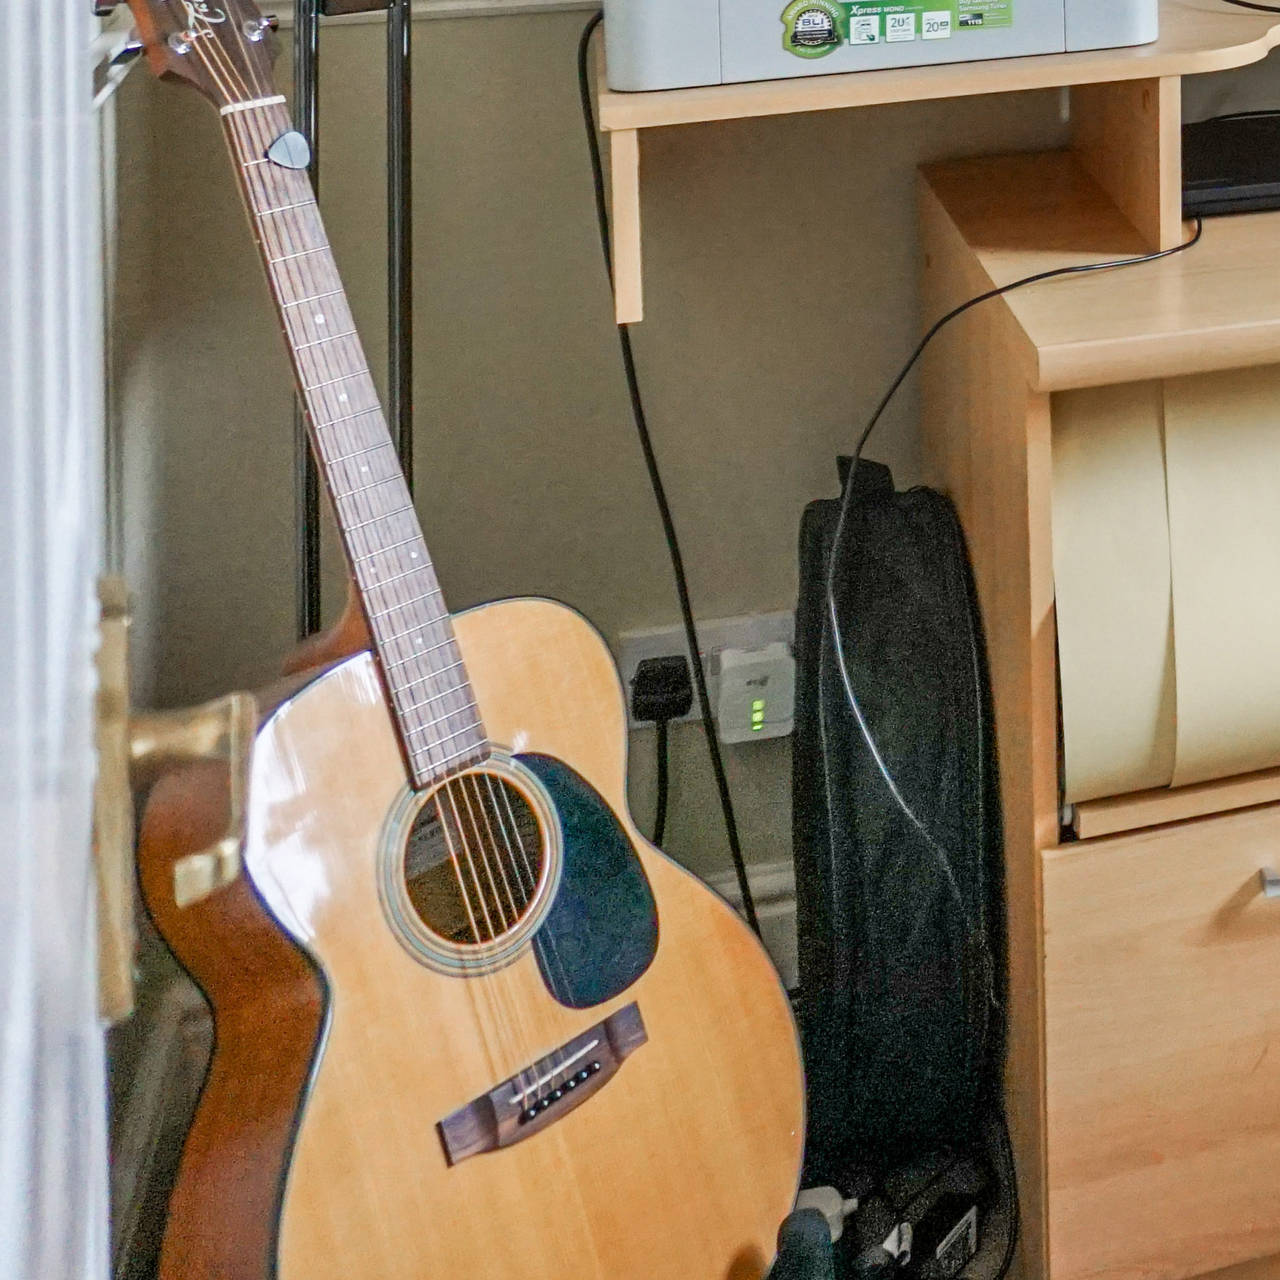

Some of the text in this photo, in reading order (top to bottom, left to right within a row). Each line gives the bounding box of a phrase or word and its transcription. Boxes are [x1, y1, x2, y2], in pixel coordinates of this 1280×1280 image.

[786, 0, 809, 19] AWARD
[850, 4, 882, 16] Xpress
[958, 4, 988, 12] Samsung
[802, 18, 824, 27] BLI
[890, 17, 905, 28] 20
[925, 22, 939, 33] 20
